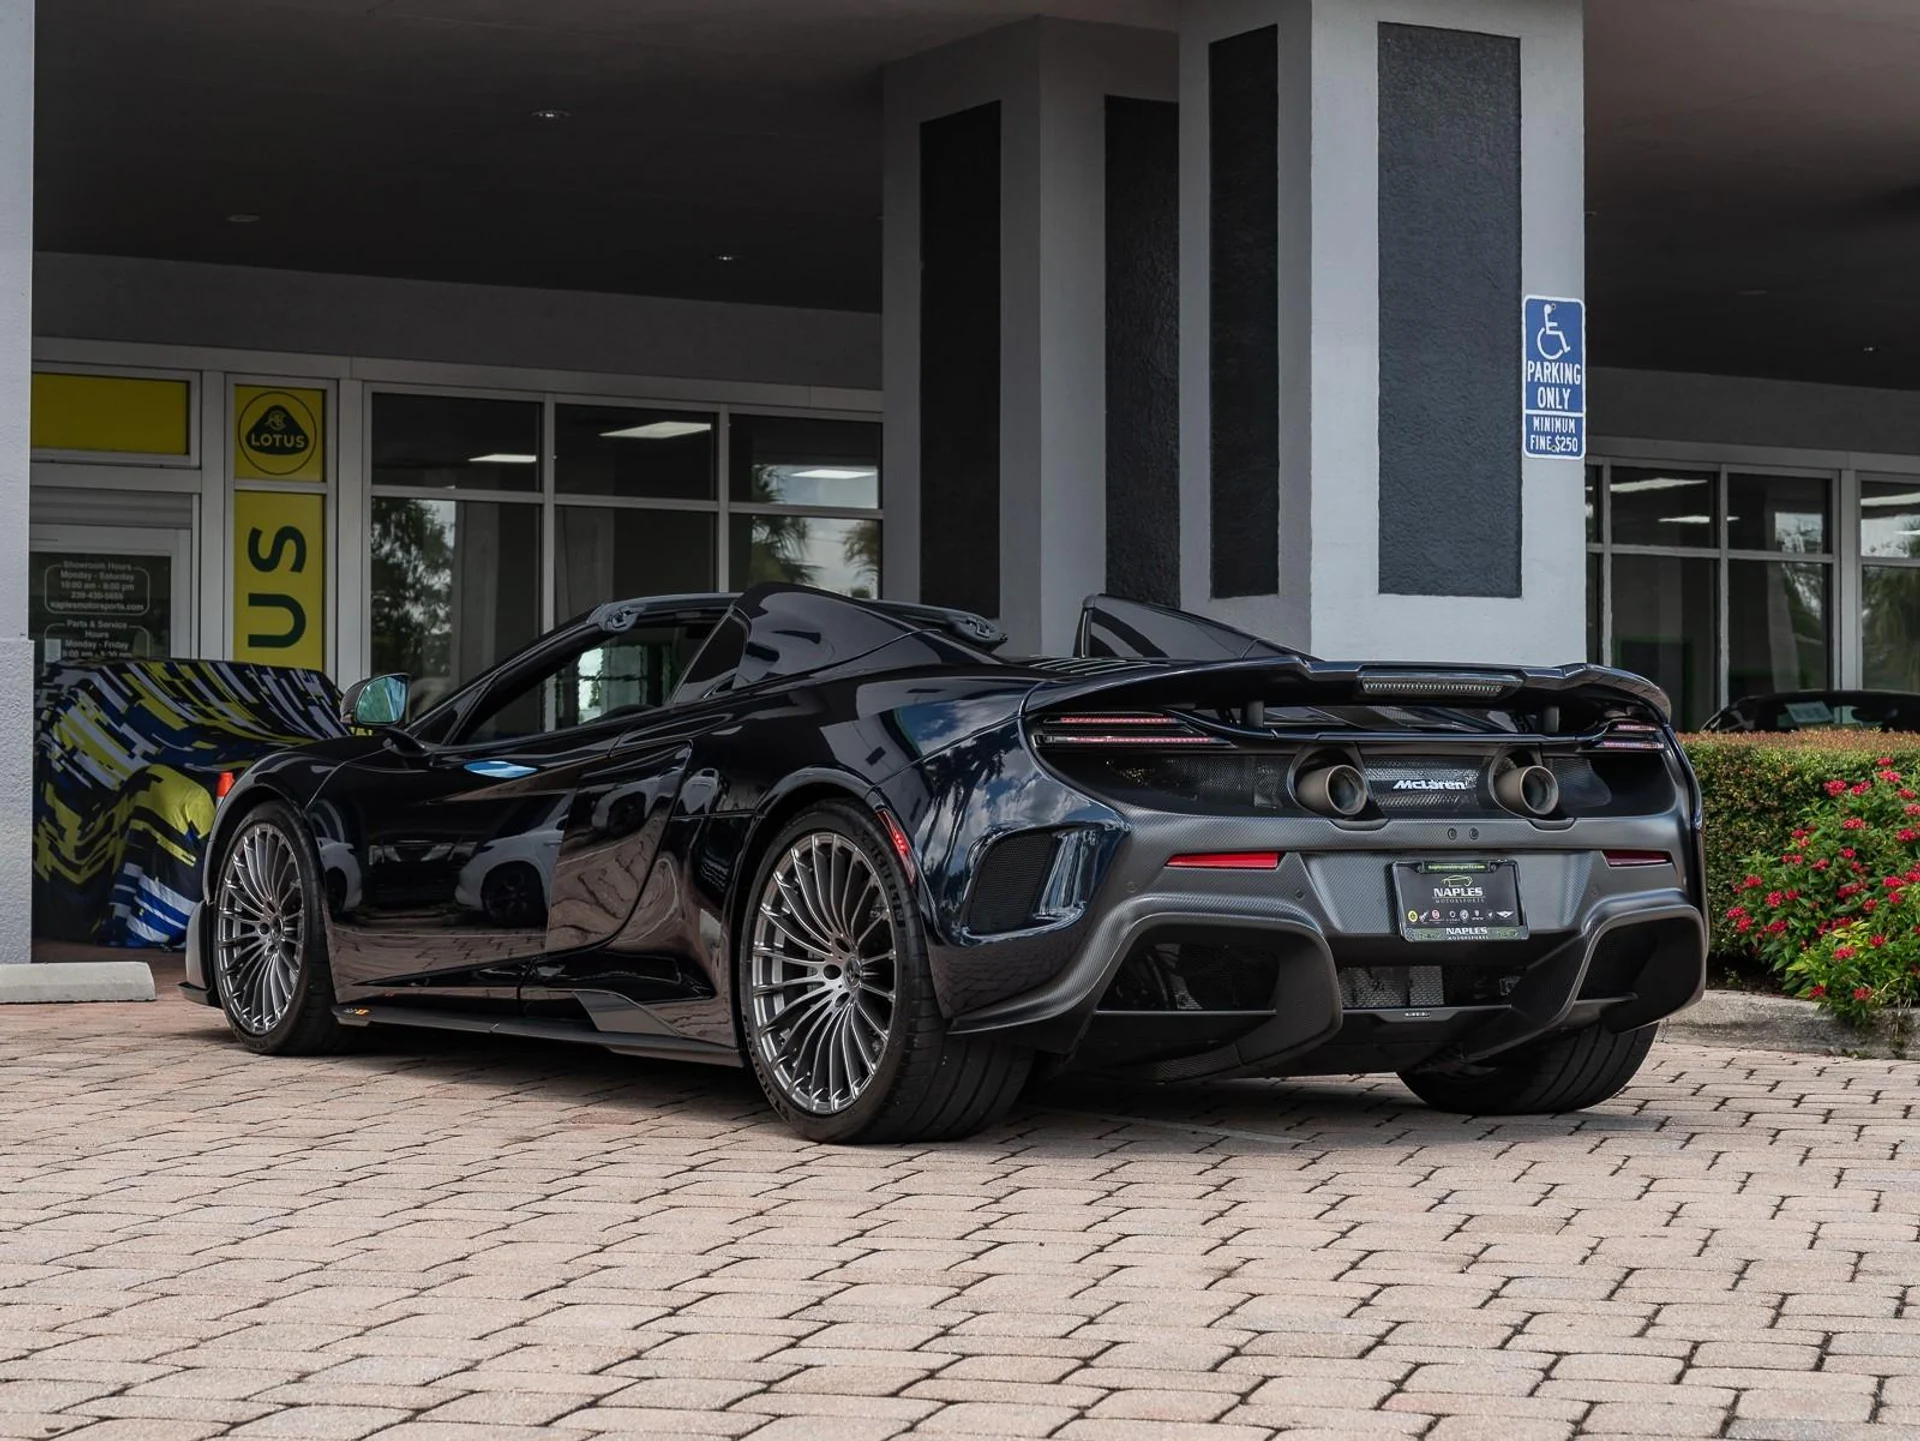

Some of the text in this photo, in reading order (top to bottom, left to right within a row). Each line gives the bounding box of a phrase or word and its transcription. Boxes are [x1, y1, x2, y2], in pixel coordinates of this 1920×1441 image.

[1527, 360, 1581, 385] PARKING
[1537, 386, 1571, 410] ONLY
[1533, 416, 1575, 434] MINIMUM
[251, 433, 305, 448] LOTUS
[1530, 435, 1578, 453] FINE $250
[63, 561, 132, 571] Showroom Hours
[60, 571, 92, 580] Monday
[100, 572, 134, 582] Saturday
[67, 620, 87, 628] Parts
[98, 621, 128, 629] Service
[65, 640, 97, 649] Monday
[104, 641, 129, 650] Friday
[1393, 779, 1468, 790] McLaren
[1433, 887, 1483, 897] NAPLES
[1445, 927, 1488, 935] NAPLES
